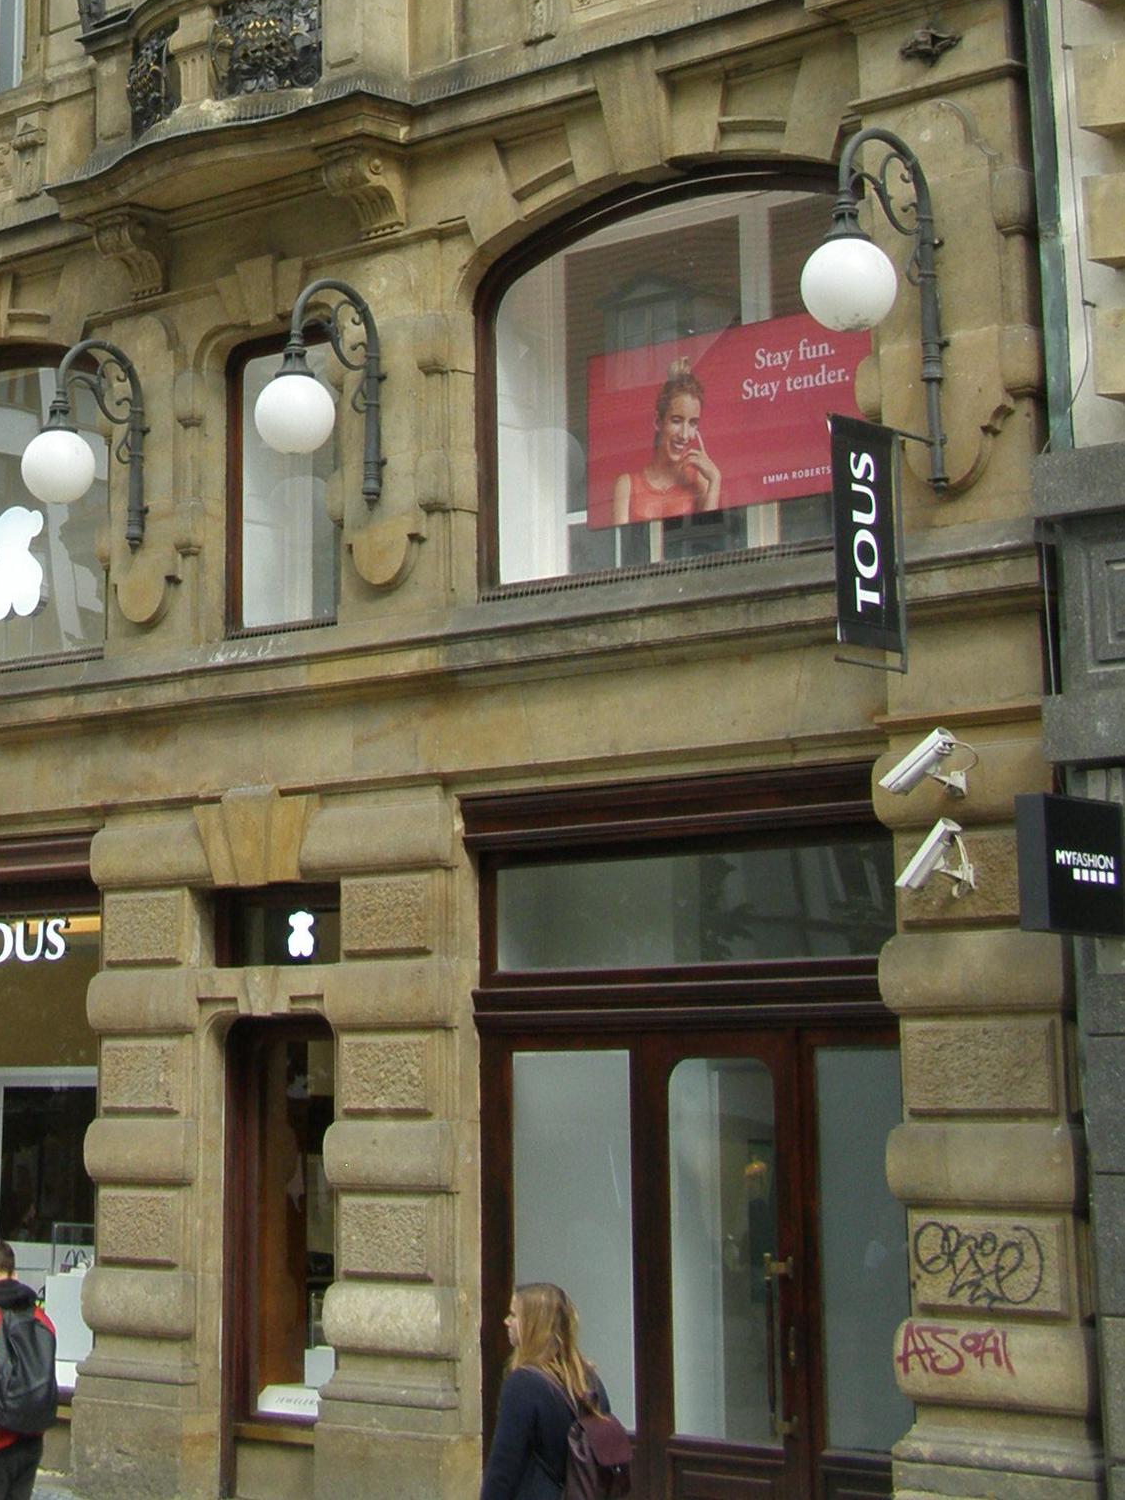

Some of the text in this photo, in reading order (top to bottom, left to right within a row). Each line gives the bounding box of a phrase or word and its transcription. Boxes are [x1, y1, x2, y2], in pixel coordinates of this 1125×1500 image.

[754, 338, 836, 371] Stay fun.
[742, 365, 850, 401] Stay tender.
[763, 465, 832, 485] EMMA ROBERTS
[850, 452, 881, 612] TOUS
[1055, 849, 1114, 870] MYFASHION
